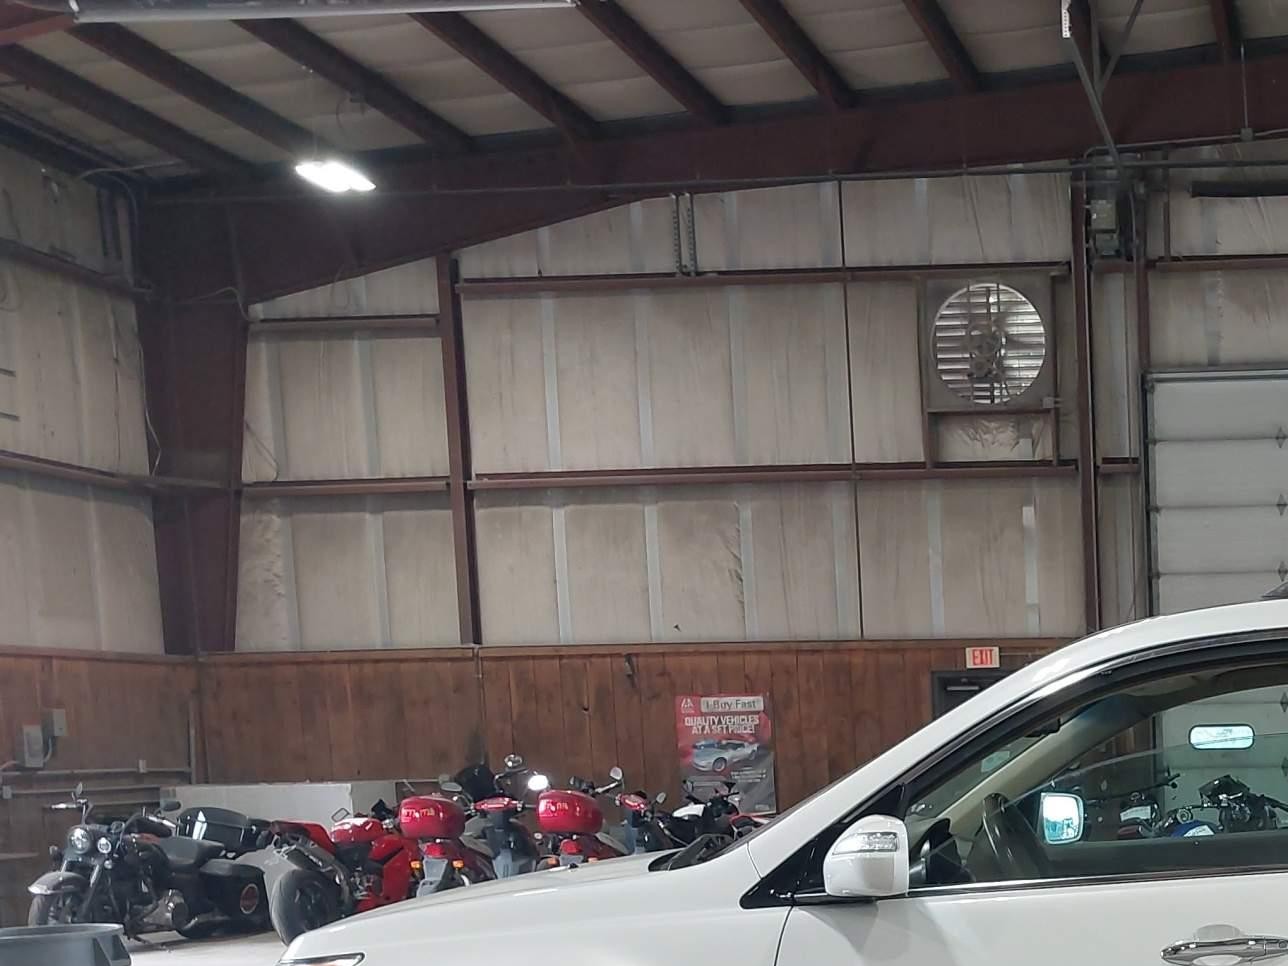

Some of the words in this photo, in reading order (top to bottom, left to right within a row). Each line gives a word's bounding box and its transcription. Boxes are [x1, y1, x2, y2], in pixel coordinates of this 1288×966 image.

[973, 648, 994, 666] EXIT
[735, 699, 757, 709] Fast
[684, 716, 719, 727] QUALITY
[720, 714, 760, 726] VEHICLES
[691, 725, 702, 735] AT
[703, 725, 711, 735] A
[712, 725, 727, 735] SET
